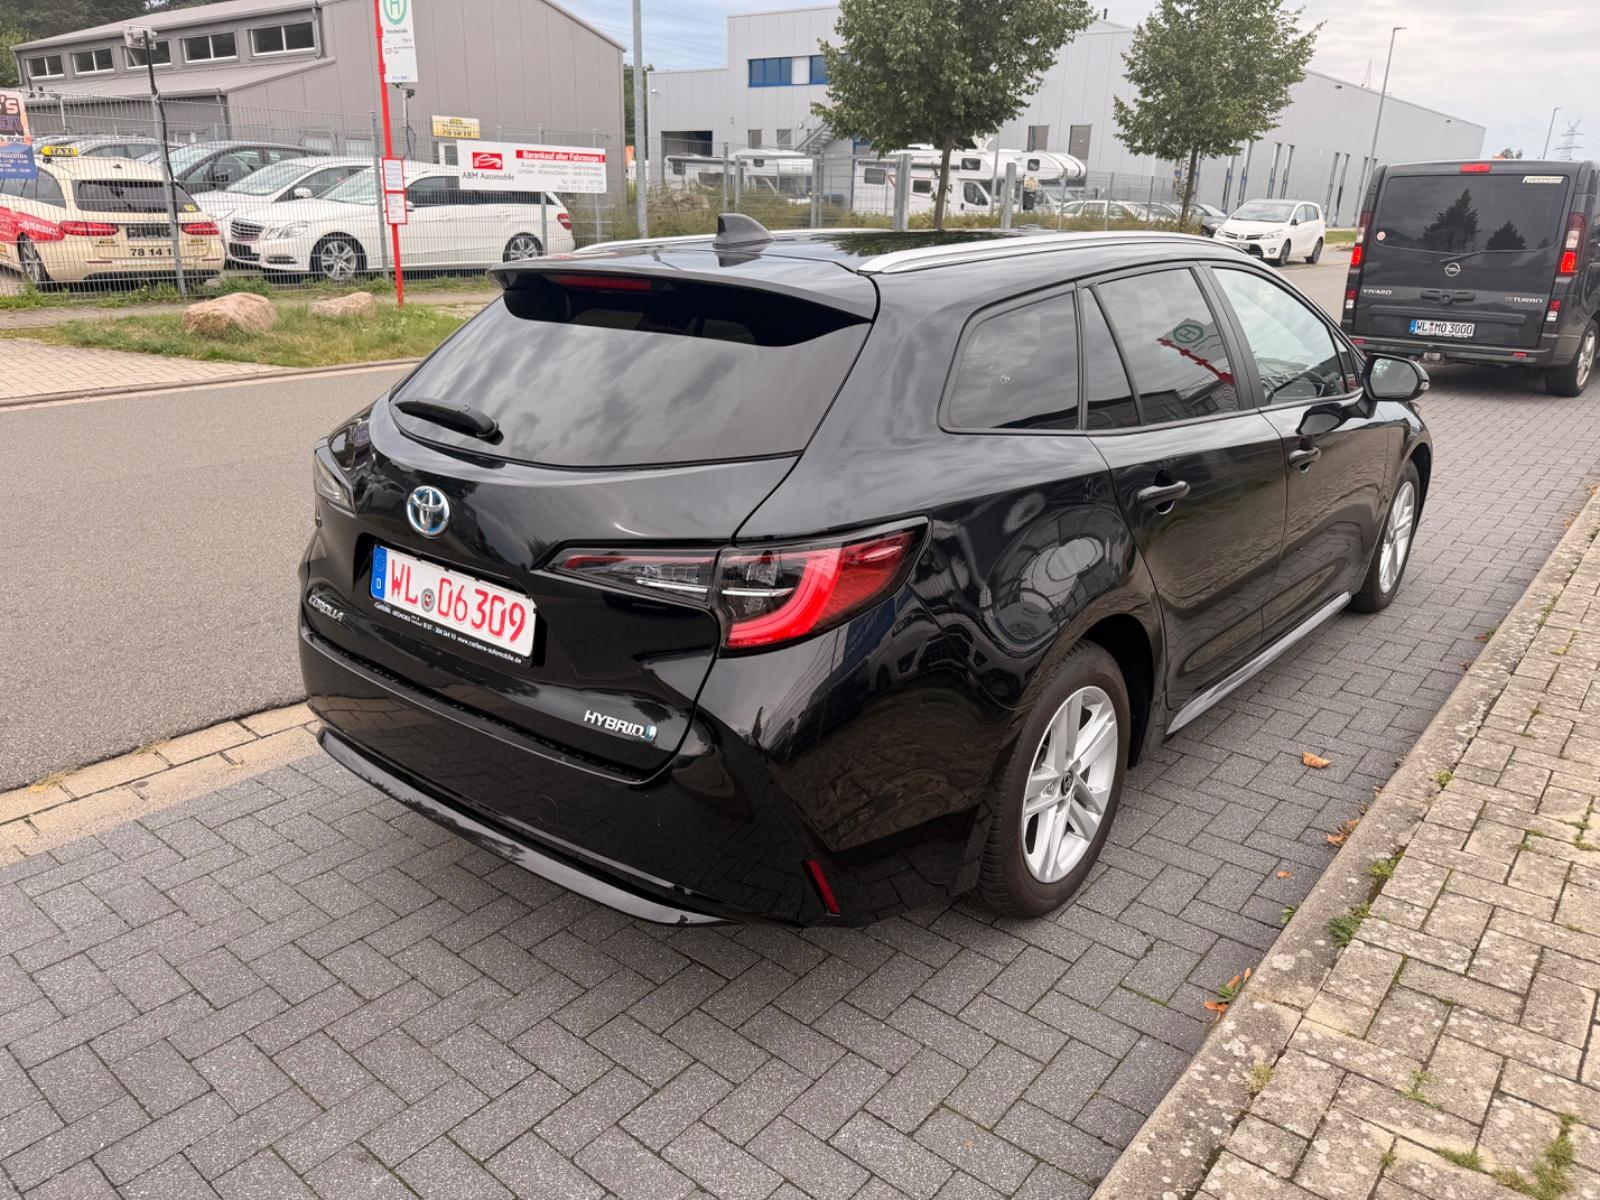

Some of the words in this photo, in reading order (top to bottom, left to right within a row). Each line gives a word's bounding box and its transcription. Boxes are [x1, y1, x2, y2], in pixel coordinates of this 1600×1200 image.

[51, 147, 72, 156] TAXI
[523, 150, 555, 160] Barankauf
[569, 152, 599, 163] Fahrzeuge
[480, 173, 515, 181] Automobile
[130, 248, 145, 256] 78
[149, 248, 162, 256] 14
[1363, 288, 1393, 296] VIVARO
[1417, 321, 1427, 332] WL
[1434, 322, 1447, 333] MO
[1449, 323, 1473, 335] 3000
[390, 558, 419, 605] WL
[437, 578, 526, 643] 06309
[584, 709, 644, 738] HYBRID
